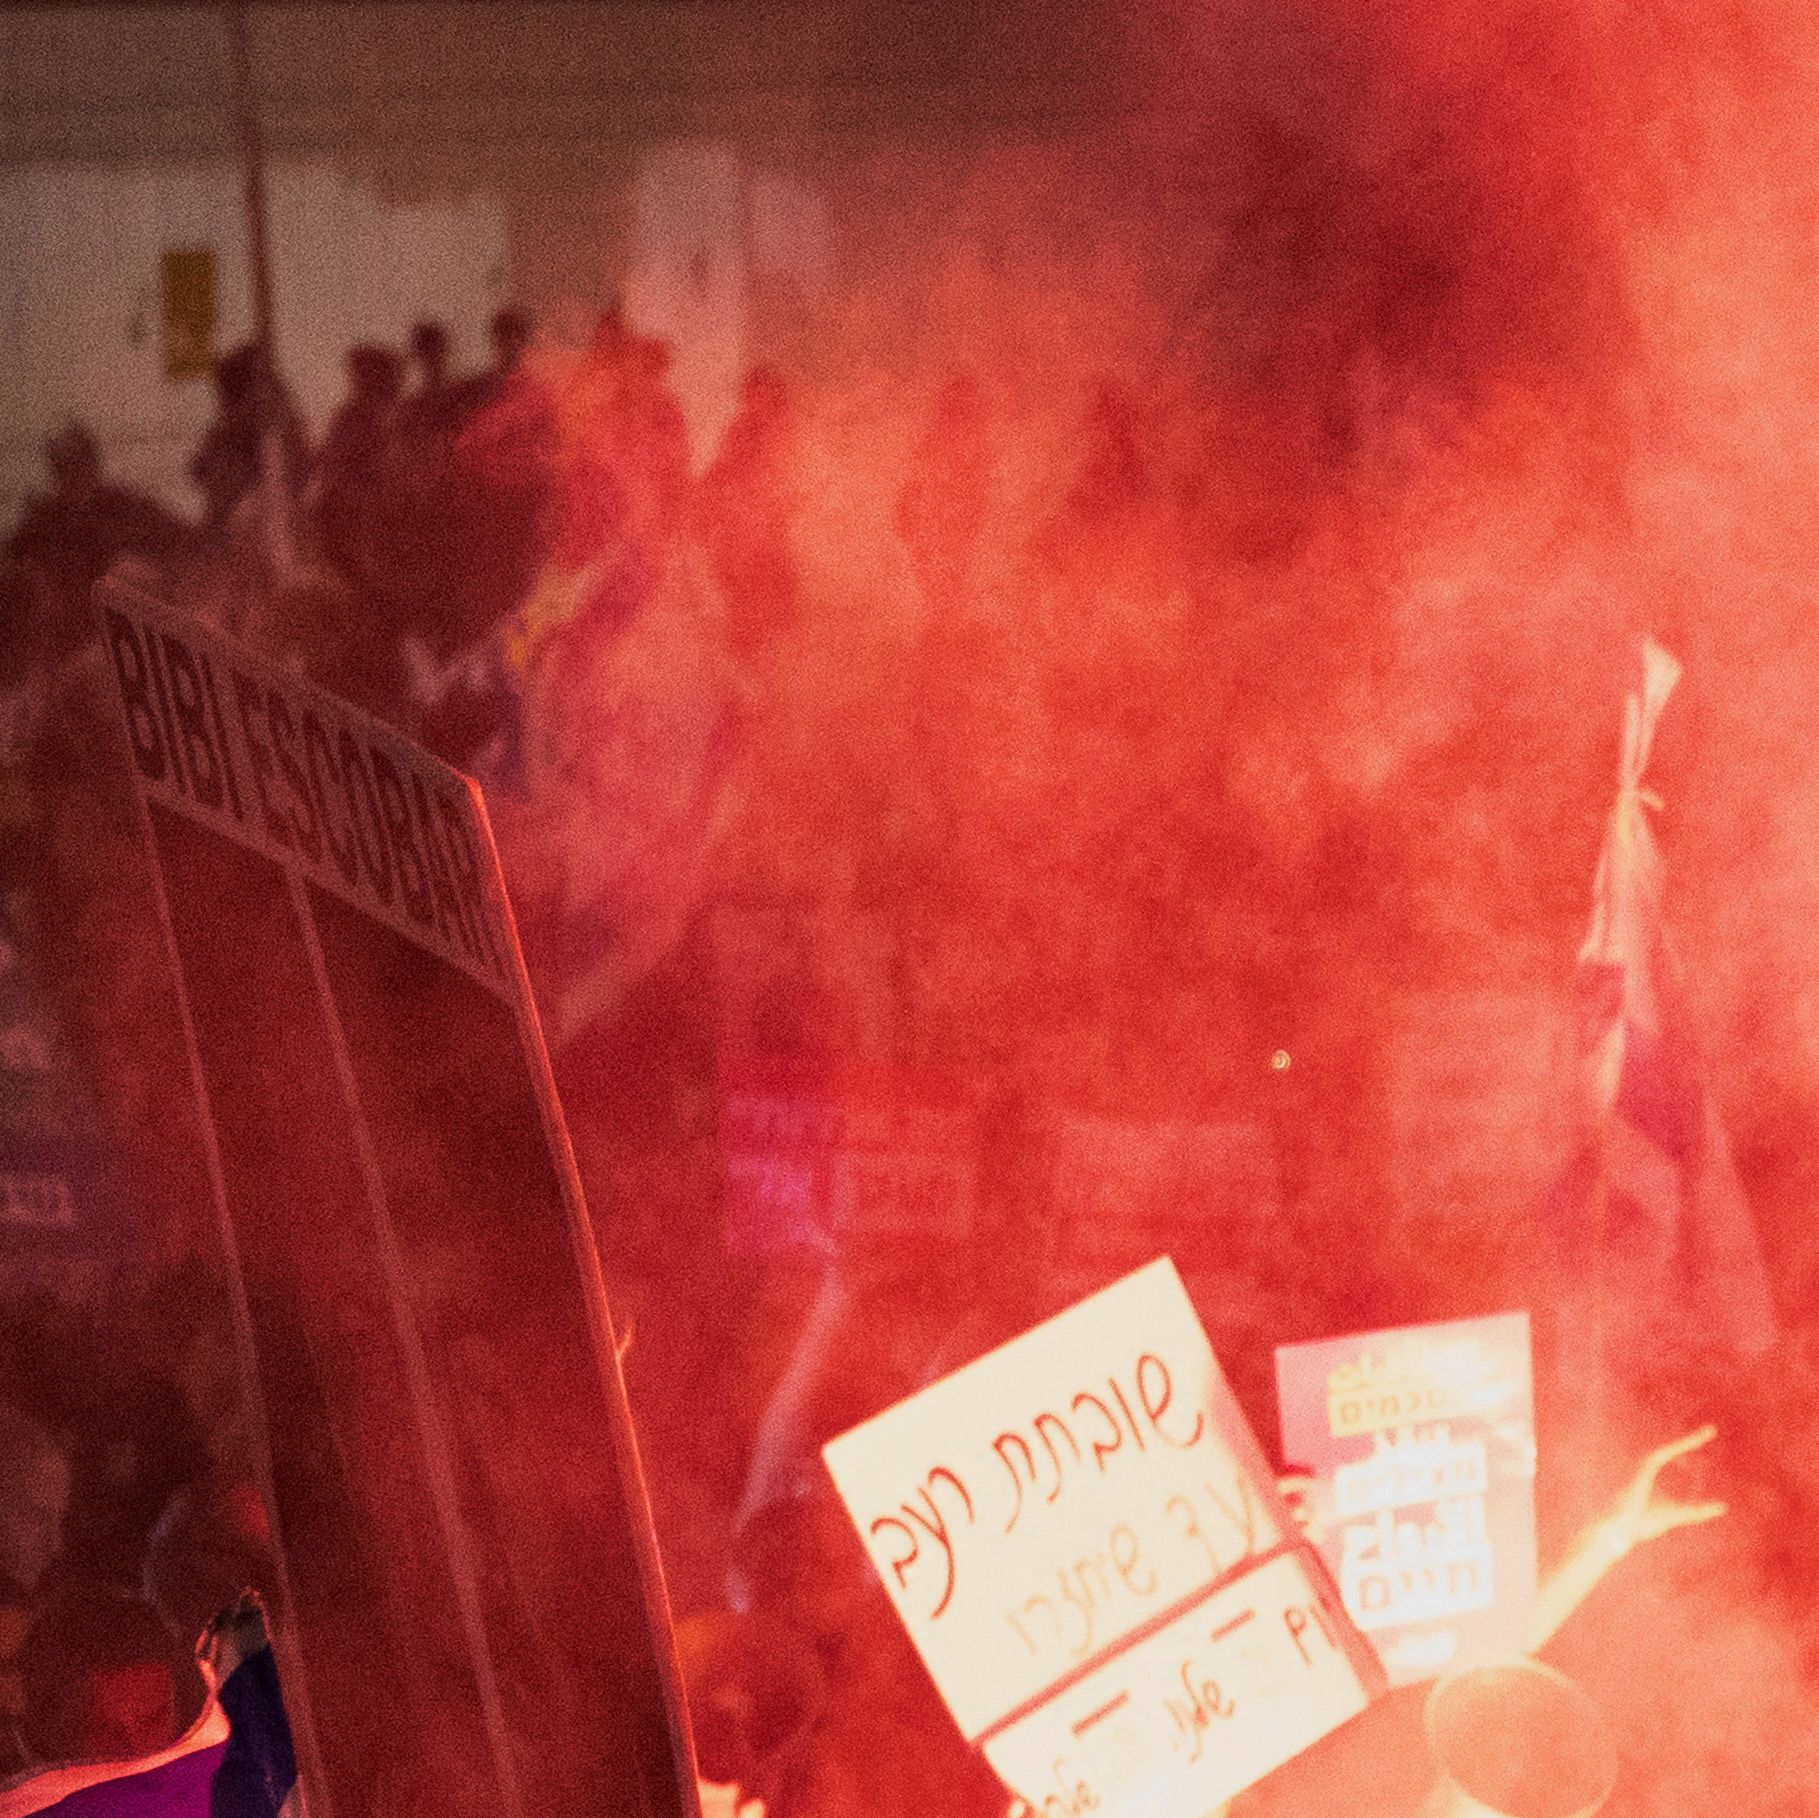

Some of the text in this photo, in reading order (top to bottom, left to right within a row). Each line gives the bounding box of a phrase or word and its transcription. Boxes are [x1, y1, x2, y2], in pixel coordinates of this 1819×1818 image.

[104, 606, 507, 982] BIBI ESCOBAR
[869, 1465, 976, 1621] רעב
[1357, 1563, 1479, 1612] חיים
